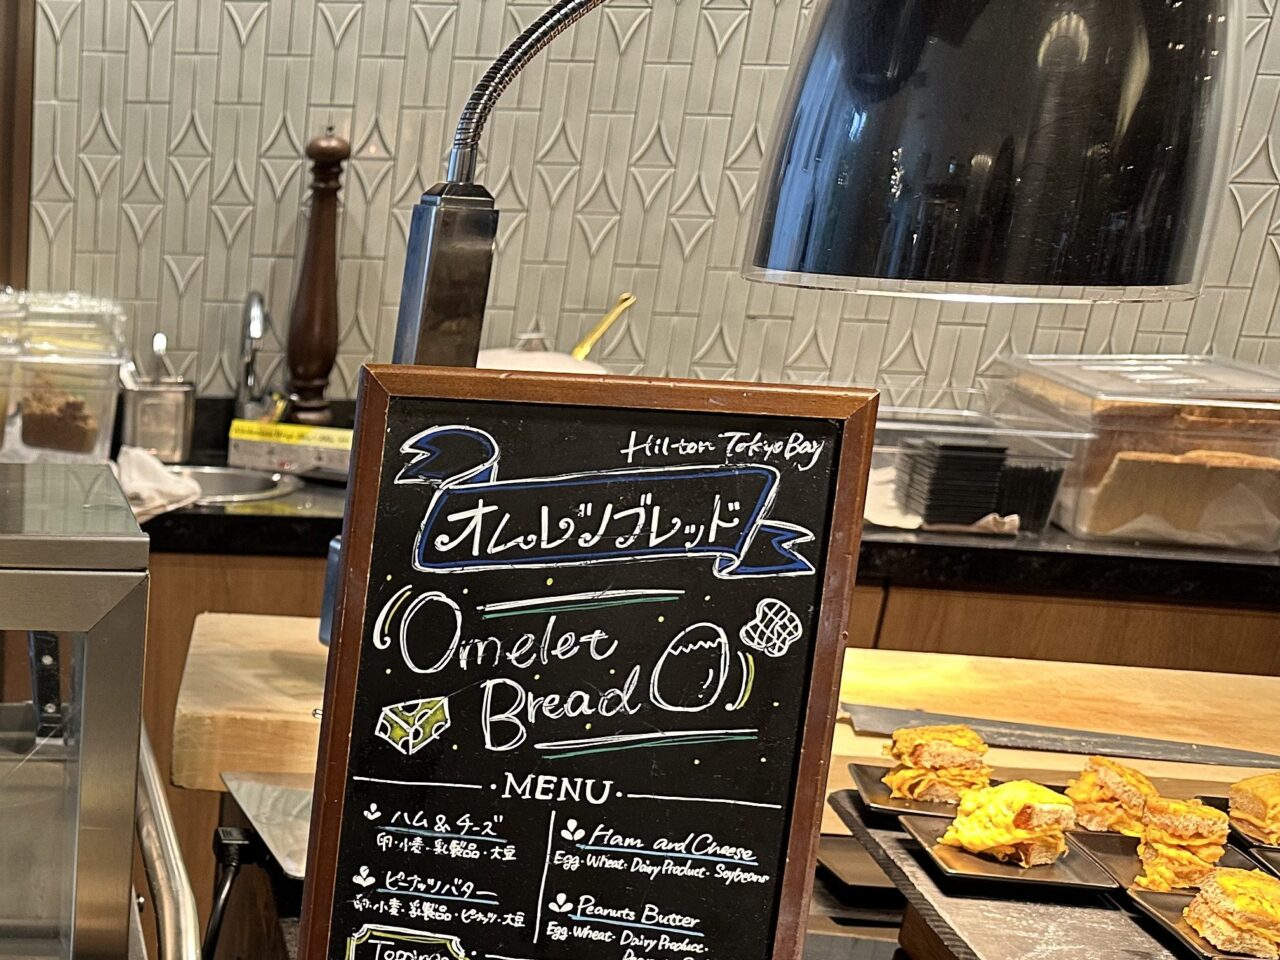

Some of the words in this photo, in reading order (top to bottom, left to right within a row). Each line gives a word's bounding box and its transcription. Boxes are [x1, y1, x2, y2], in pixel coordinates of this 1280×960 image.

[620, 430, 716, 463] Hilton
[400, 591, 619, 673] Omelet
[481, 665, 641, 751] Bread
[501, 772, 614, 805] MENU
[588, 824, 645, 848] Ham
[653, 833, 693, 853] and
[690, 833, 758, 861] Cheese
[385, 870, 499, 899] ピーナッツバター
[714, 864, 770, 885] Soybeans
[577, 894, 637, 921] Peanuts
[641, 903, 701, 928] Butter
[620, 930, 657, 952] Dairy
